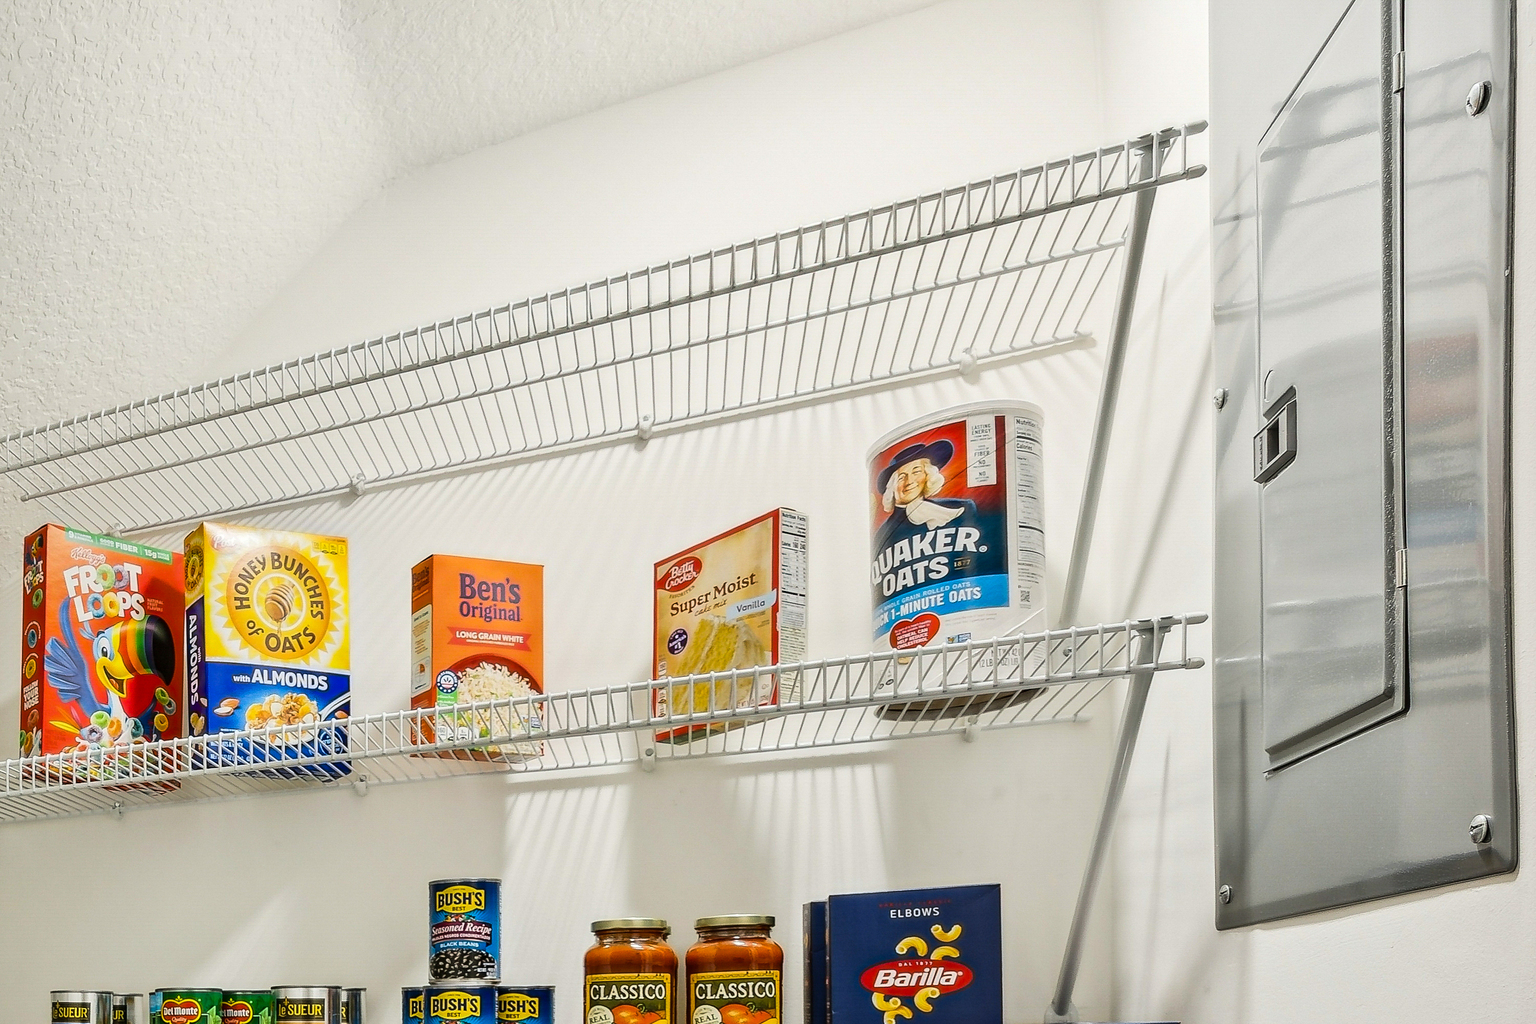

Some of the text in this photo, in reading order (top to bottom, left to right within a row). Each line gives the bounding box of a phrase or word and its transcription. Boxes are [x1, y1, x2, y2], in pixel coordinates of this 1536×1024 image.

[71, 547, 106, 566] Kellogg's
[115, 542, 138, 554] FIBER
[871, 527, 980, 587] QUAKER
[669, 560, 695, 579] Betty
[882, 556, 949, 597] OATS
[63, 562, 142, 598] FROOT
[234, 554, 266, 610] HONEY
[270, 552, 324, 620] BUNCHES
[459, 572, 521, 604] Ben's
[665, 571, 698, 590] Crocker
[670, 592, 711, 617] Super
[713, 572, 756, 600] Moist
[902, 593, 921, 603] GRAIN
[922, 586, 950, 596] ROLLED
[952, 582, 971, 590] OATS
[74, 591, 146, 622] LOOPS
[459, 601, 521, 622] Original
[736, 600, 766, 612] Vanilla
[891, 593, 945, 620] 1-MINUTE
[949, 587, 982, 603] OATS
[246, 620, 316, 653] of OATS
[456, 631, 477, 640] LONG
[478, 632, 502, 641] GRAIN
[502, 634, 524, 644] WHITE
[188, 614, 199, 706] ALMONDS
[232, 668, 328, 691] with ALMONDS
[438, 891, 482, 908] BUSH'S
[890, 907, 940, 918] ELBOWS
[432, 922, 492, 936] Seasoned Recipe
[874, 967, 958, 988] Barilla
[590, 984, 666, 1000] CLASSICO
[696, 982, 775, 1000] CLASSICO
[58, 1007, 88, 1018] SUEUR
[164, 1006, 198, 1016] Del Monte
[225, 1008, 250, 1016] Monte
[278, 1004, 322, 1018] Le SUEUR
[432, 998, 478, 1014] BUSH'S
[589, 1014, 610, 1024] REAL
[694, 1014, 718, 1024] REAL
